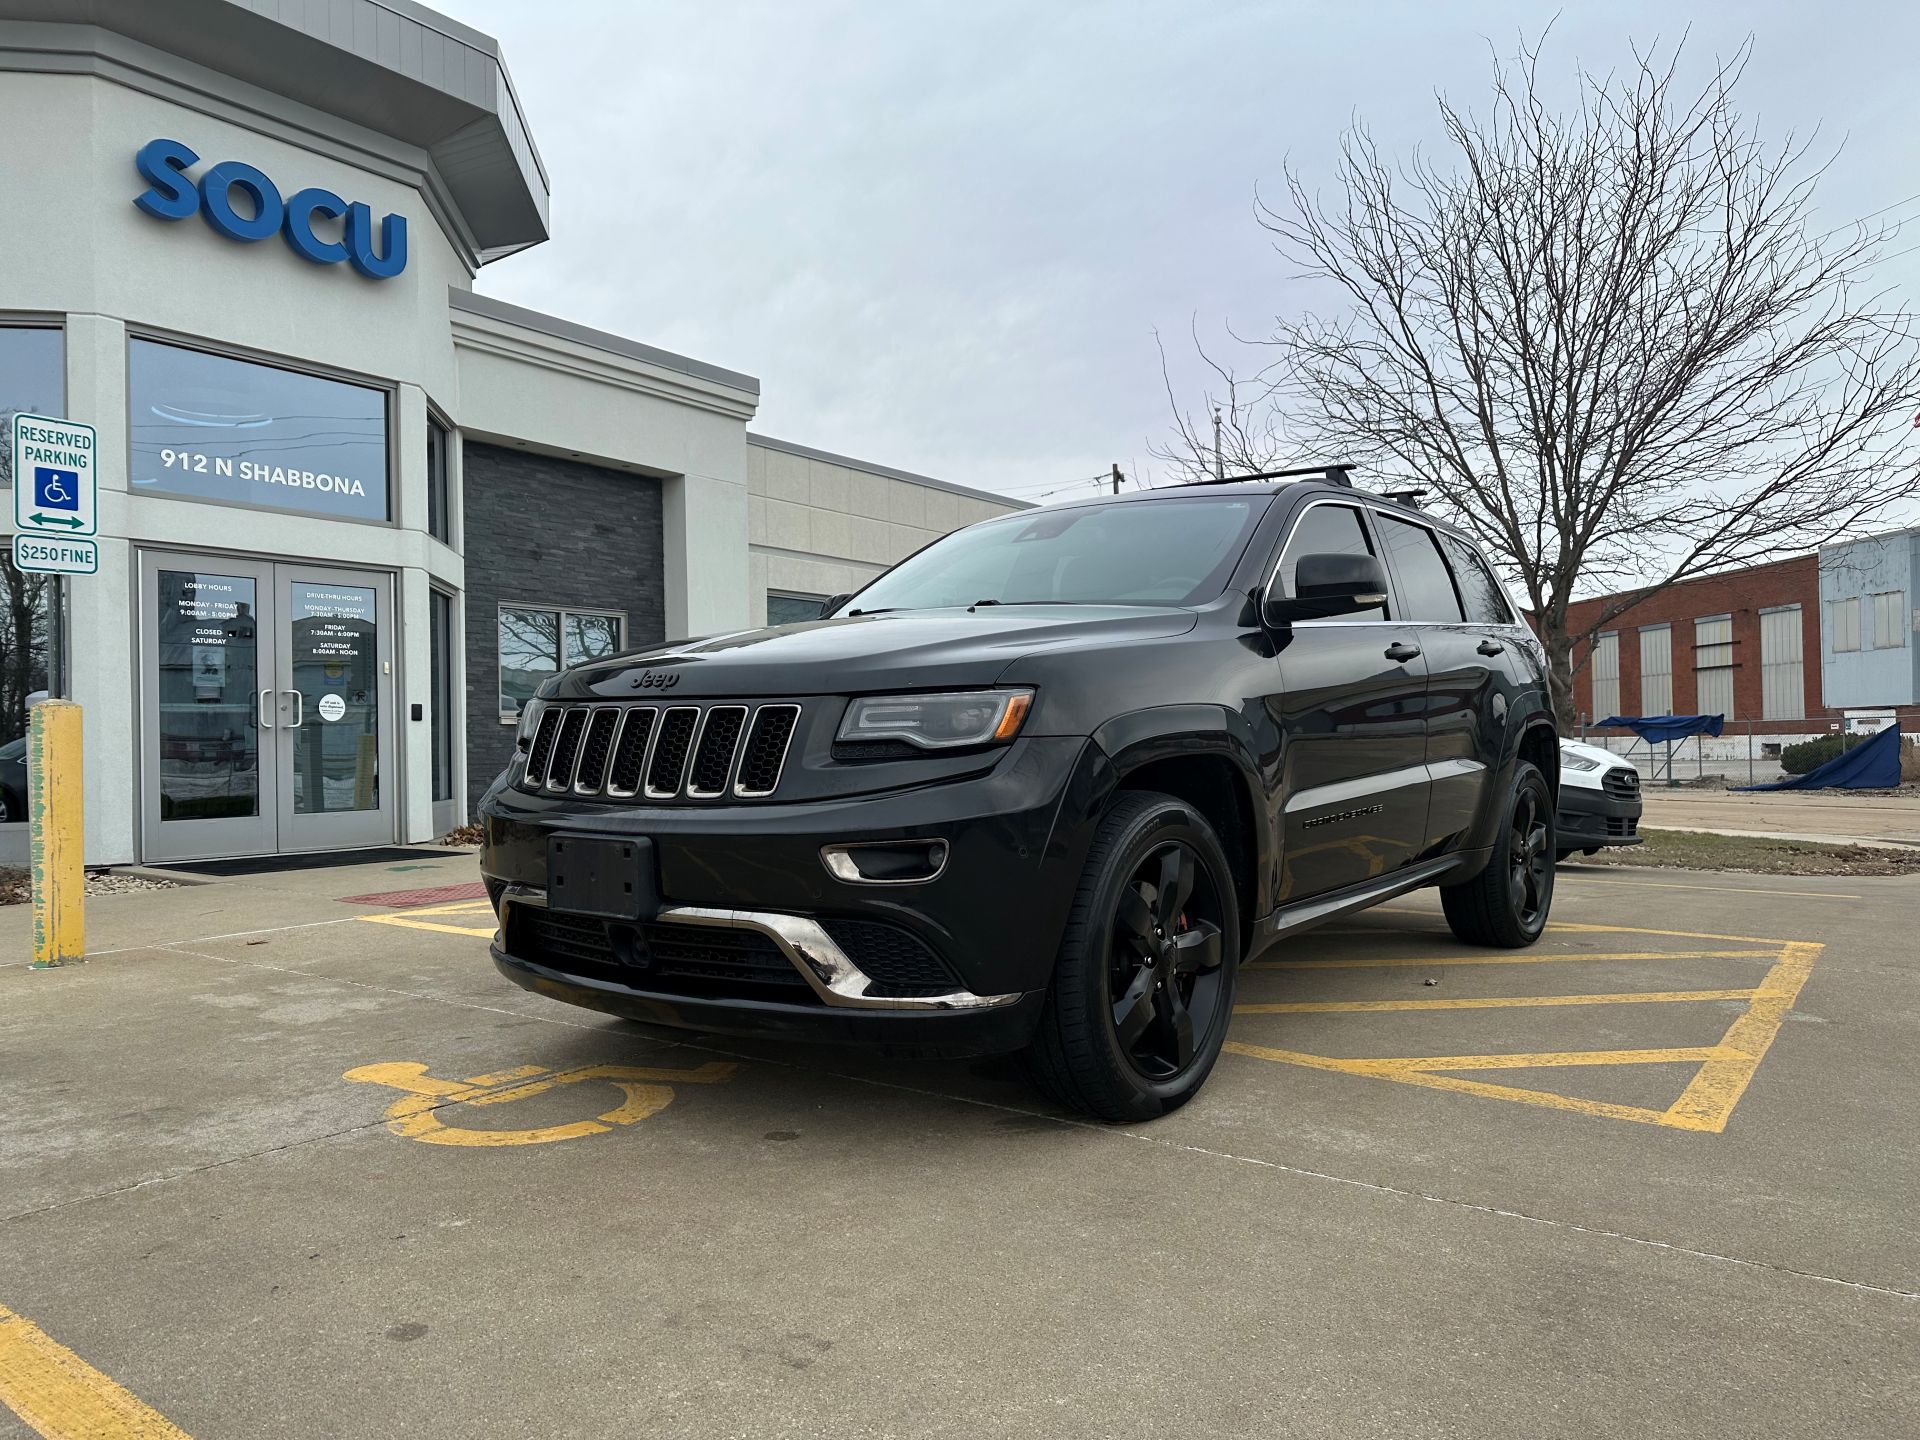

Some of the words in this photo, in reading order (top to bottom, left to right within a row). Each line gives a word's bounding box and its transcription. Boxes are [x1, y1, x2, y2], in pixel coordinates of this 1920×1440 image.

[132, 138, 408, 281] SOCU
[20, 426, 91, 450] RESERVED
[25, 446, 87, 469] PARKING
[160, 449, 208, 473] 912
[215, 457, 232, 477] N
[239, 461, 366, 497] SHABBONA
[21, 543, 58, 561] $250
[61, 549, 94, 564] FINE
[184, 582, 207, 590] LOBBY
[208, 584, 232, 592] HOURS
[178, 600, 210, 608] MONDAY
[214, 602, 238, 610] FRIDAY
[334, 606, 365, 614] THURSDAY
[180, 609, 207, 617] 9:00AM
[211, 611, 237, 619] 5:00PM
[195, 628, 223, 636] CLOSED
[310, 629, 334, 637] 7:30AM
[191, 637, 227, 645] SATURDAY
[319, 642, 351, 650] SATURDAY
[631, 669, 680, 692] Jeep
